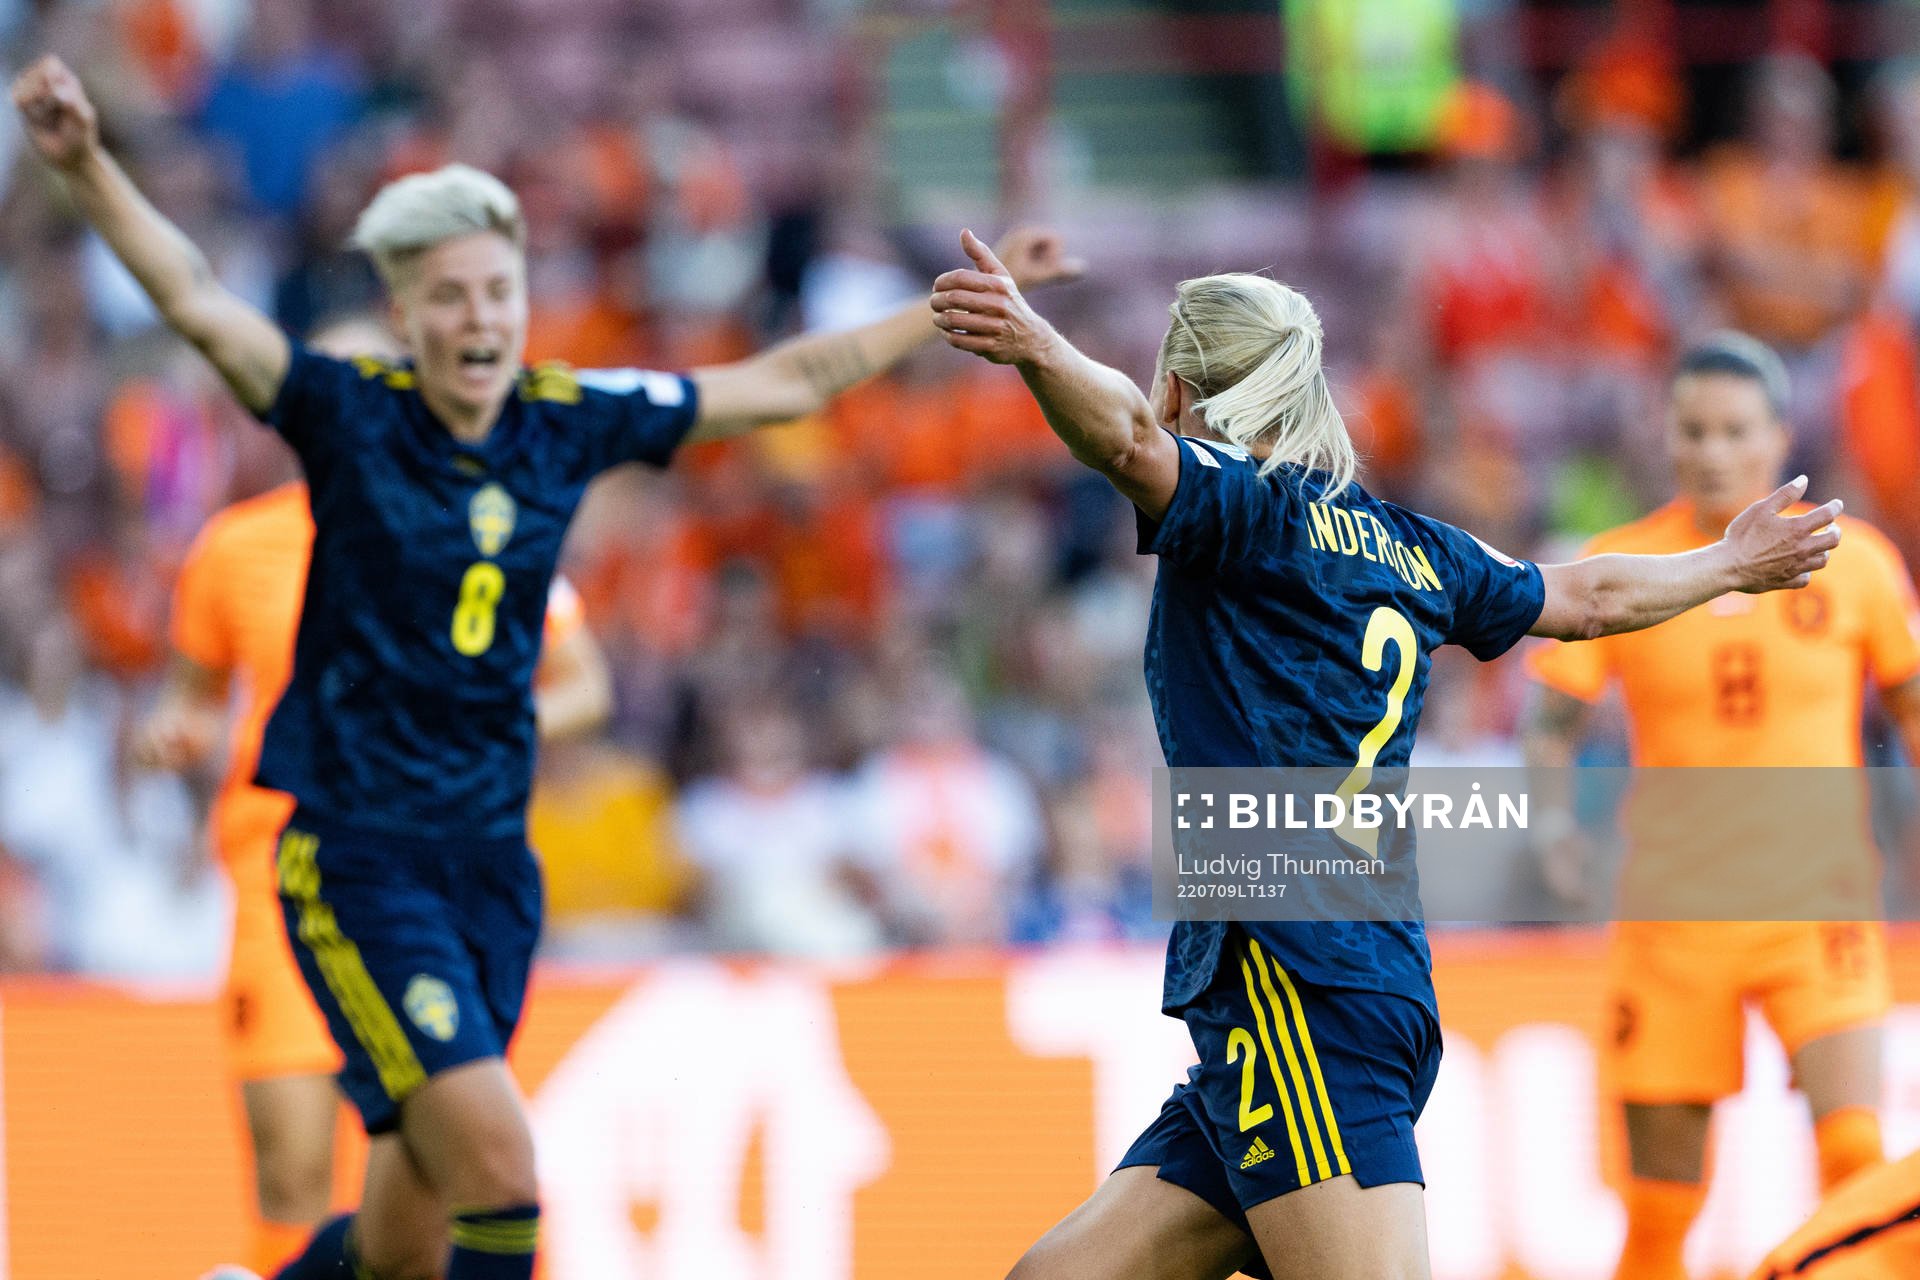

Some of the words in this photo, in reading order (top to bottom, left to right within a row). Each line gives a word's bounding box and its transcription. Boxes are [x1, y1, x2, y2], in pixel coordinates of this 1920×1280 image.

[451, 561, 504, 656] 8
[1331, 606, 1418, 859] 2
[1226, 1027, 1274, 1133] 2
[1240, 1149, 1275, 1169] adidas
